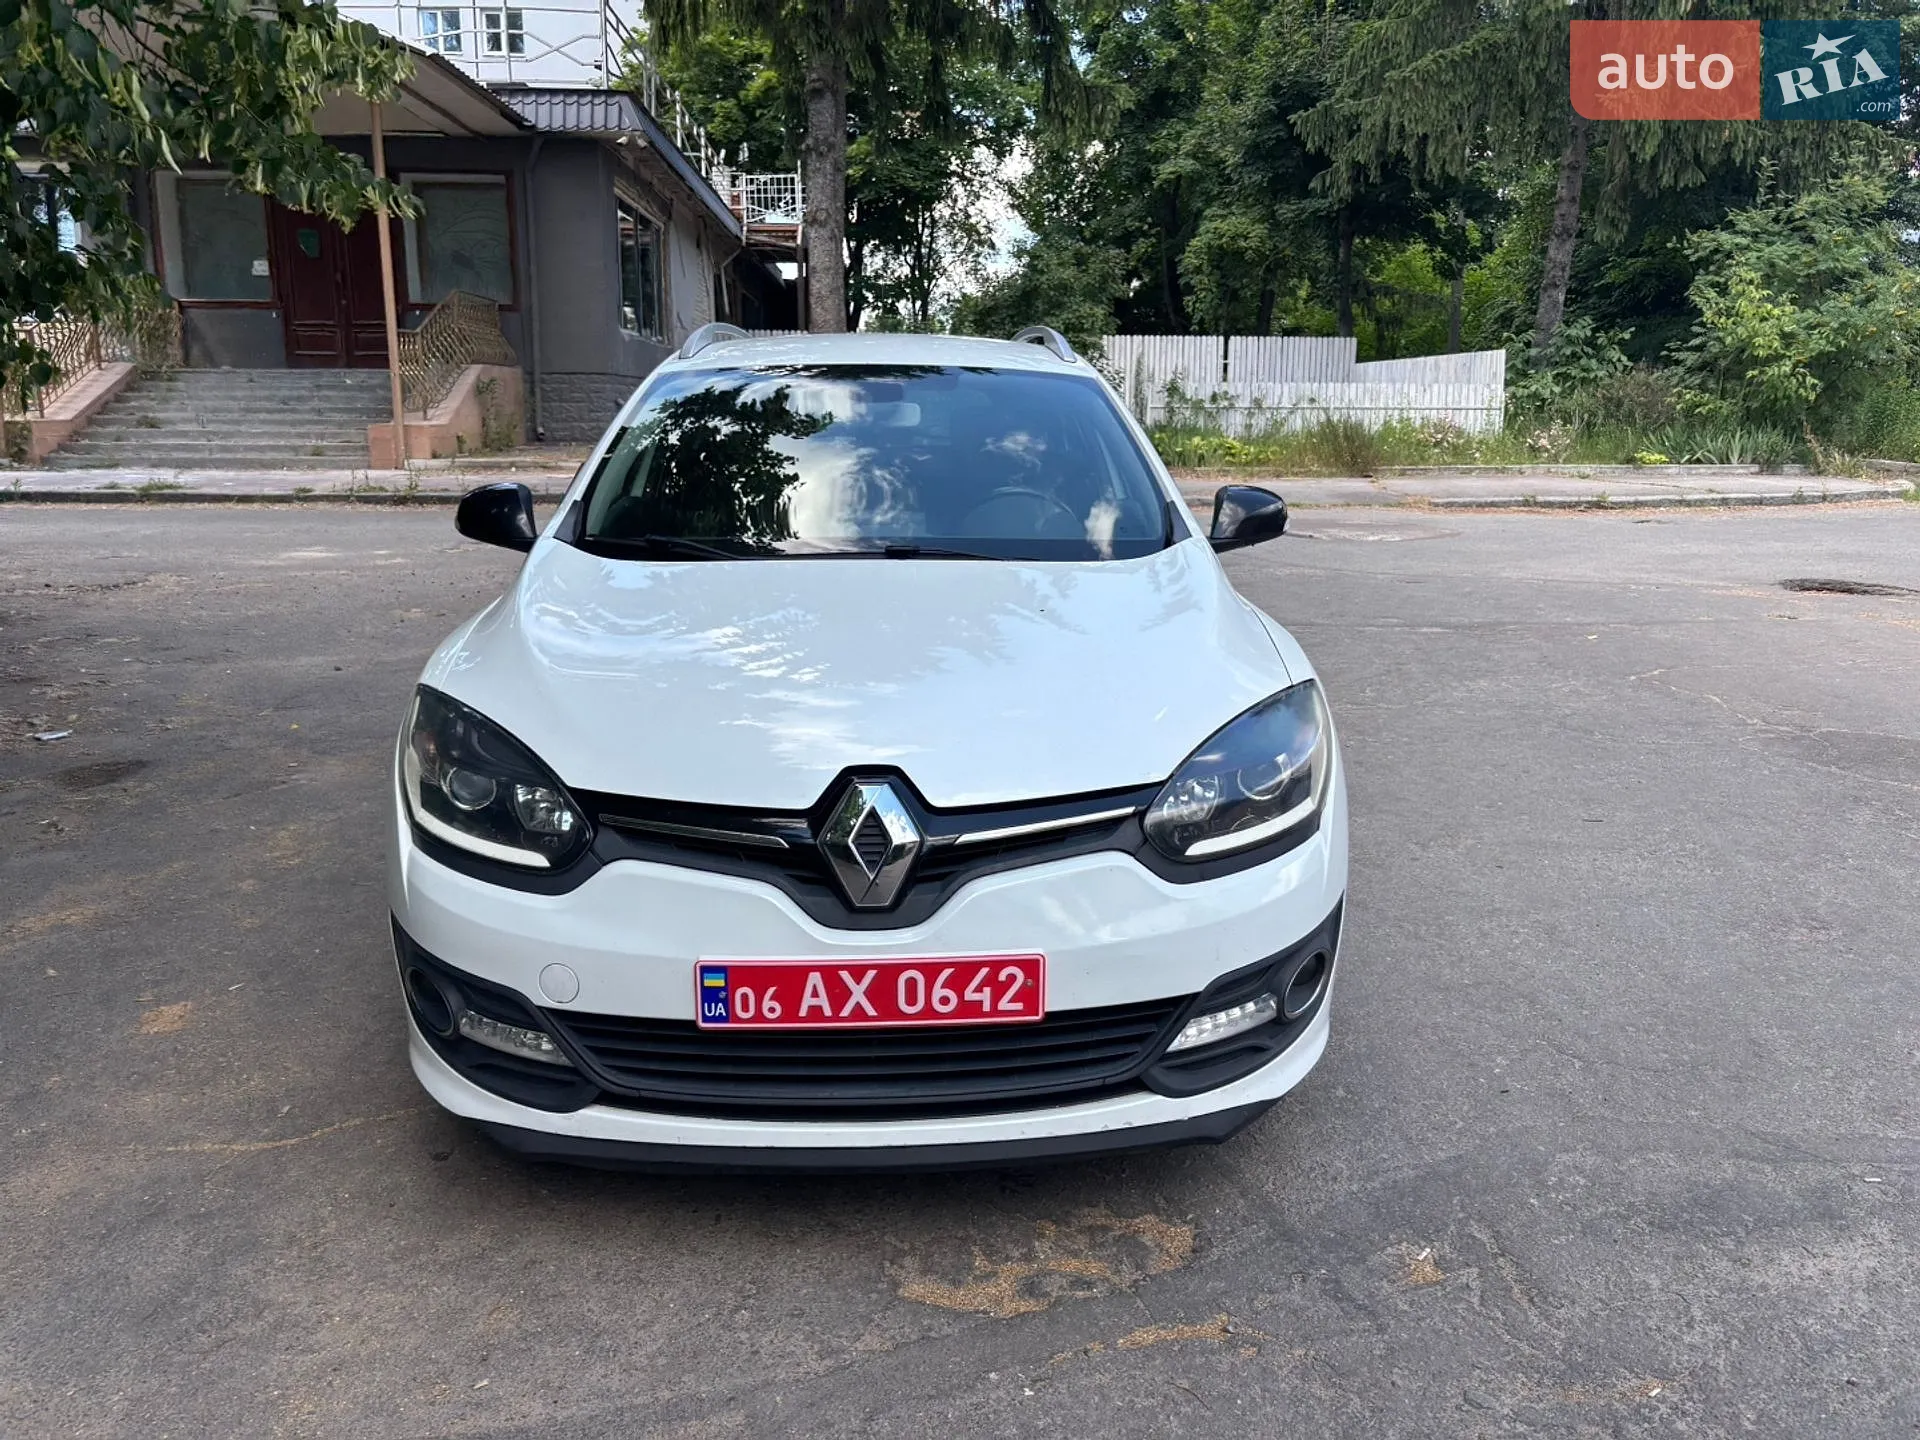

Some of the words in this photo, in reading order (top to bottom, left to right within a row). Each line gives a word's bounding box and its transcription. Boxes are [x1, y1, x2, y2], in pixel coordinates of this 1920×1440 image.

[704, 1002, 727, 1017] UA
[735, 986, 782, 1020] 06
[798, 969, 879, 1018] AX
[897, 965, 1025, 1015] 0642
